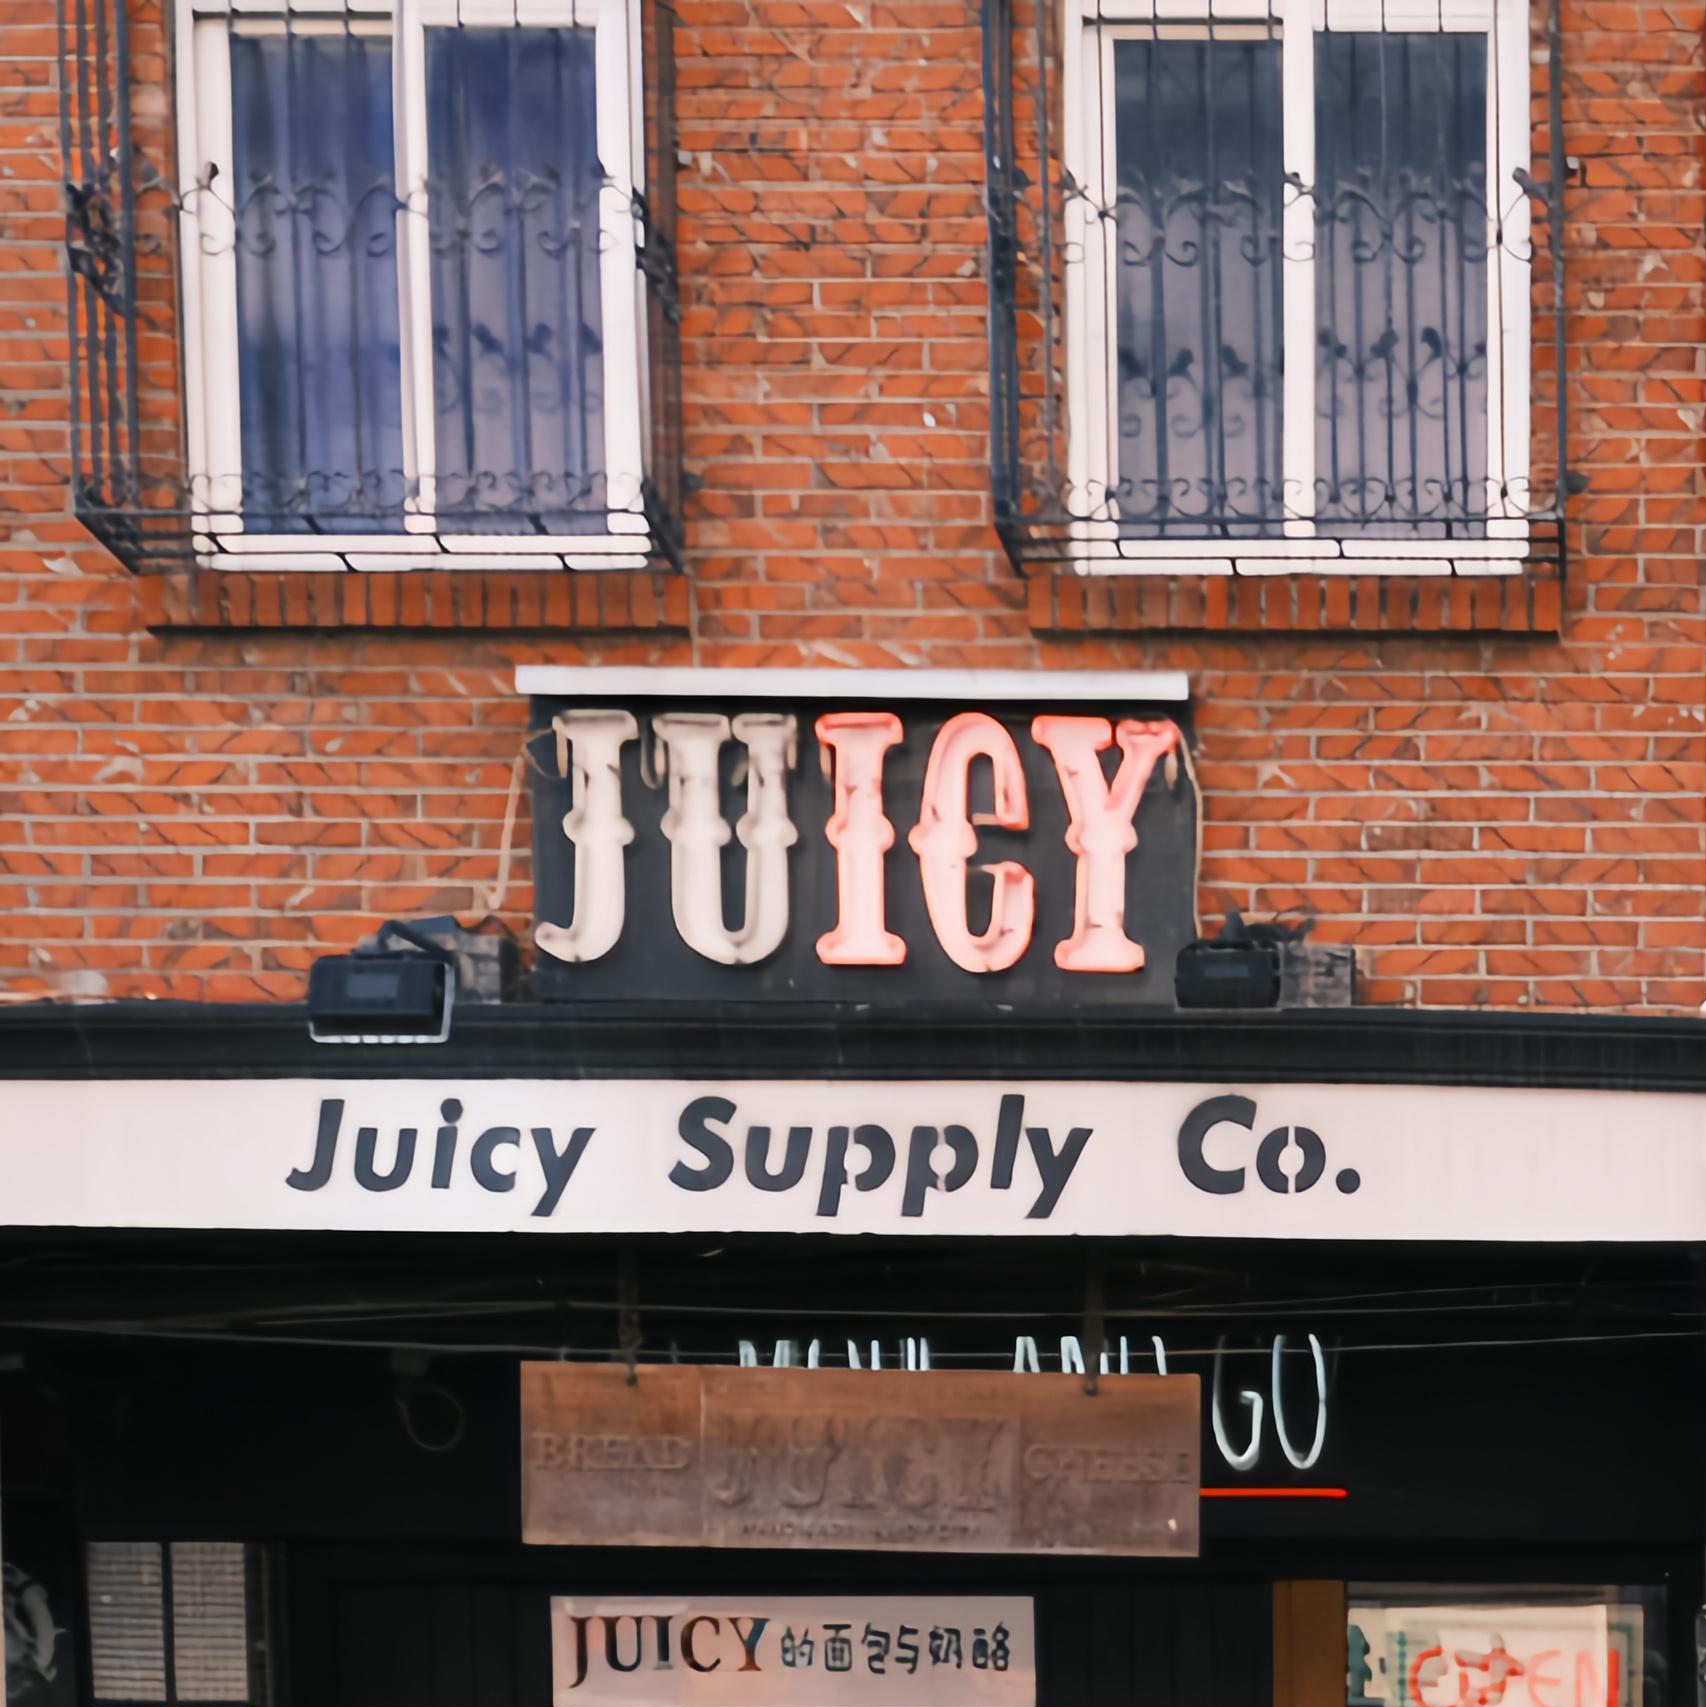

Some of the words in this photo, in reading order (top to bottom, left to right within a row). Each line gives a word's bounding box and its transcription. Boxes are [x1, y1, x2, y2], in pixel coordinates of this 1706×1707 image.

[534, 709, 1180, 973] JUICY
[285, 1098, 597, 1217] Juicy
[668, 1094, 1093, 1219] Supply
[1178, 1094, 1361, 1195] Co.
[570, 1616, 771, 1688] JUICY
[781, 1621, 1010, 1675] 的面包与奶酪
